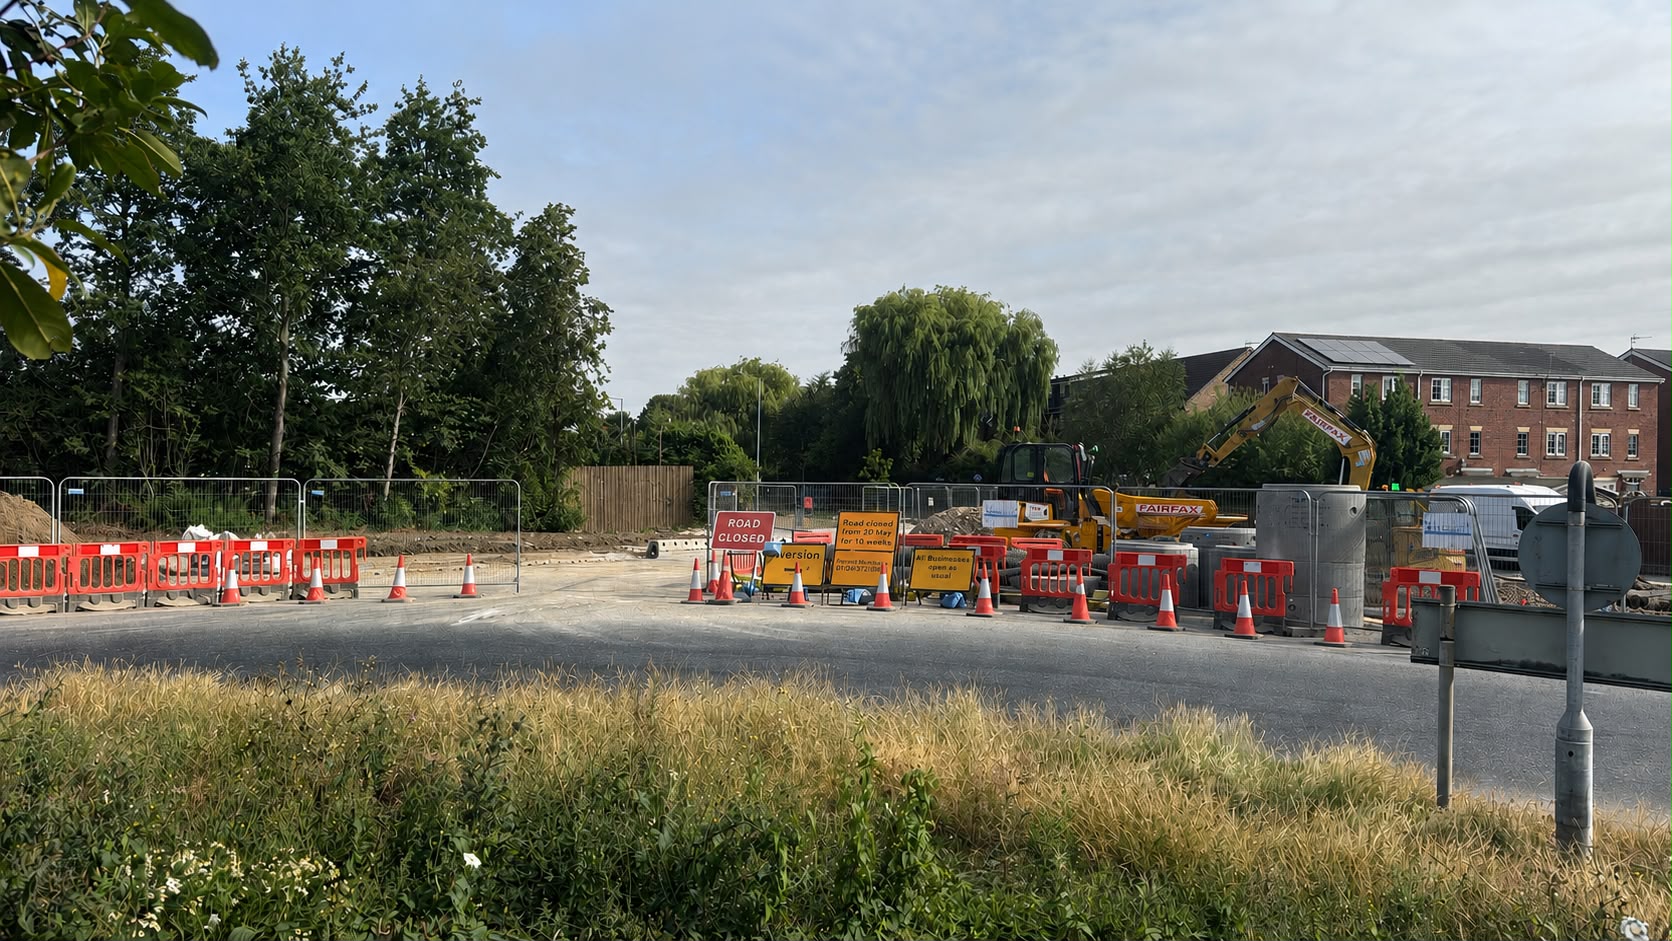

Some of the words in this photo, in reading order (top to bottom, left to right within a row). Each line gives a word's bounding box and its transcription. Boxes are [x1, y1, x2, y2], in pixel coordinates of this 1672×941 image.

[1139, 505, 1198, 513] FAIRFAX
[728, 519, 761, 528] ROAD
[718, 533, 765, 543] CLOSED
[776, 549, 820, 560] version
